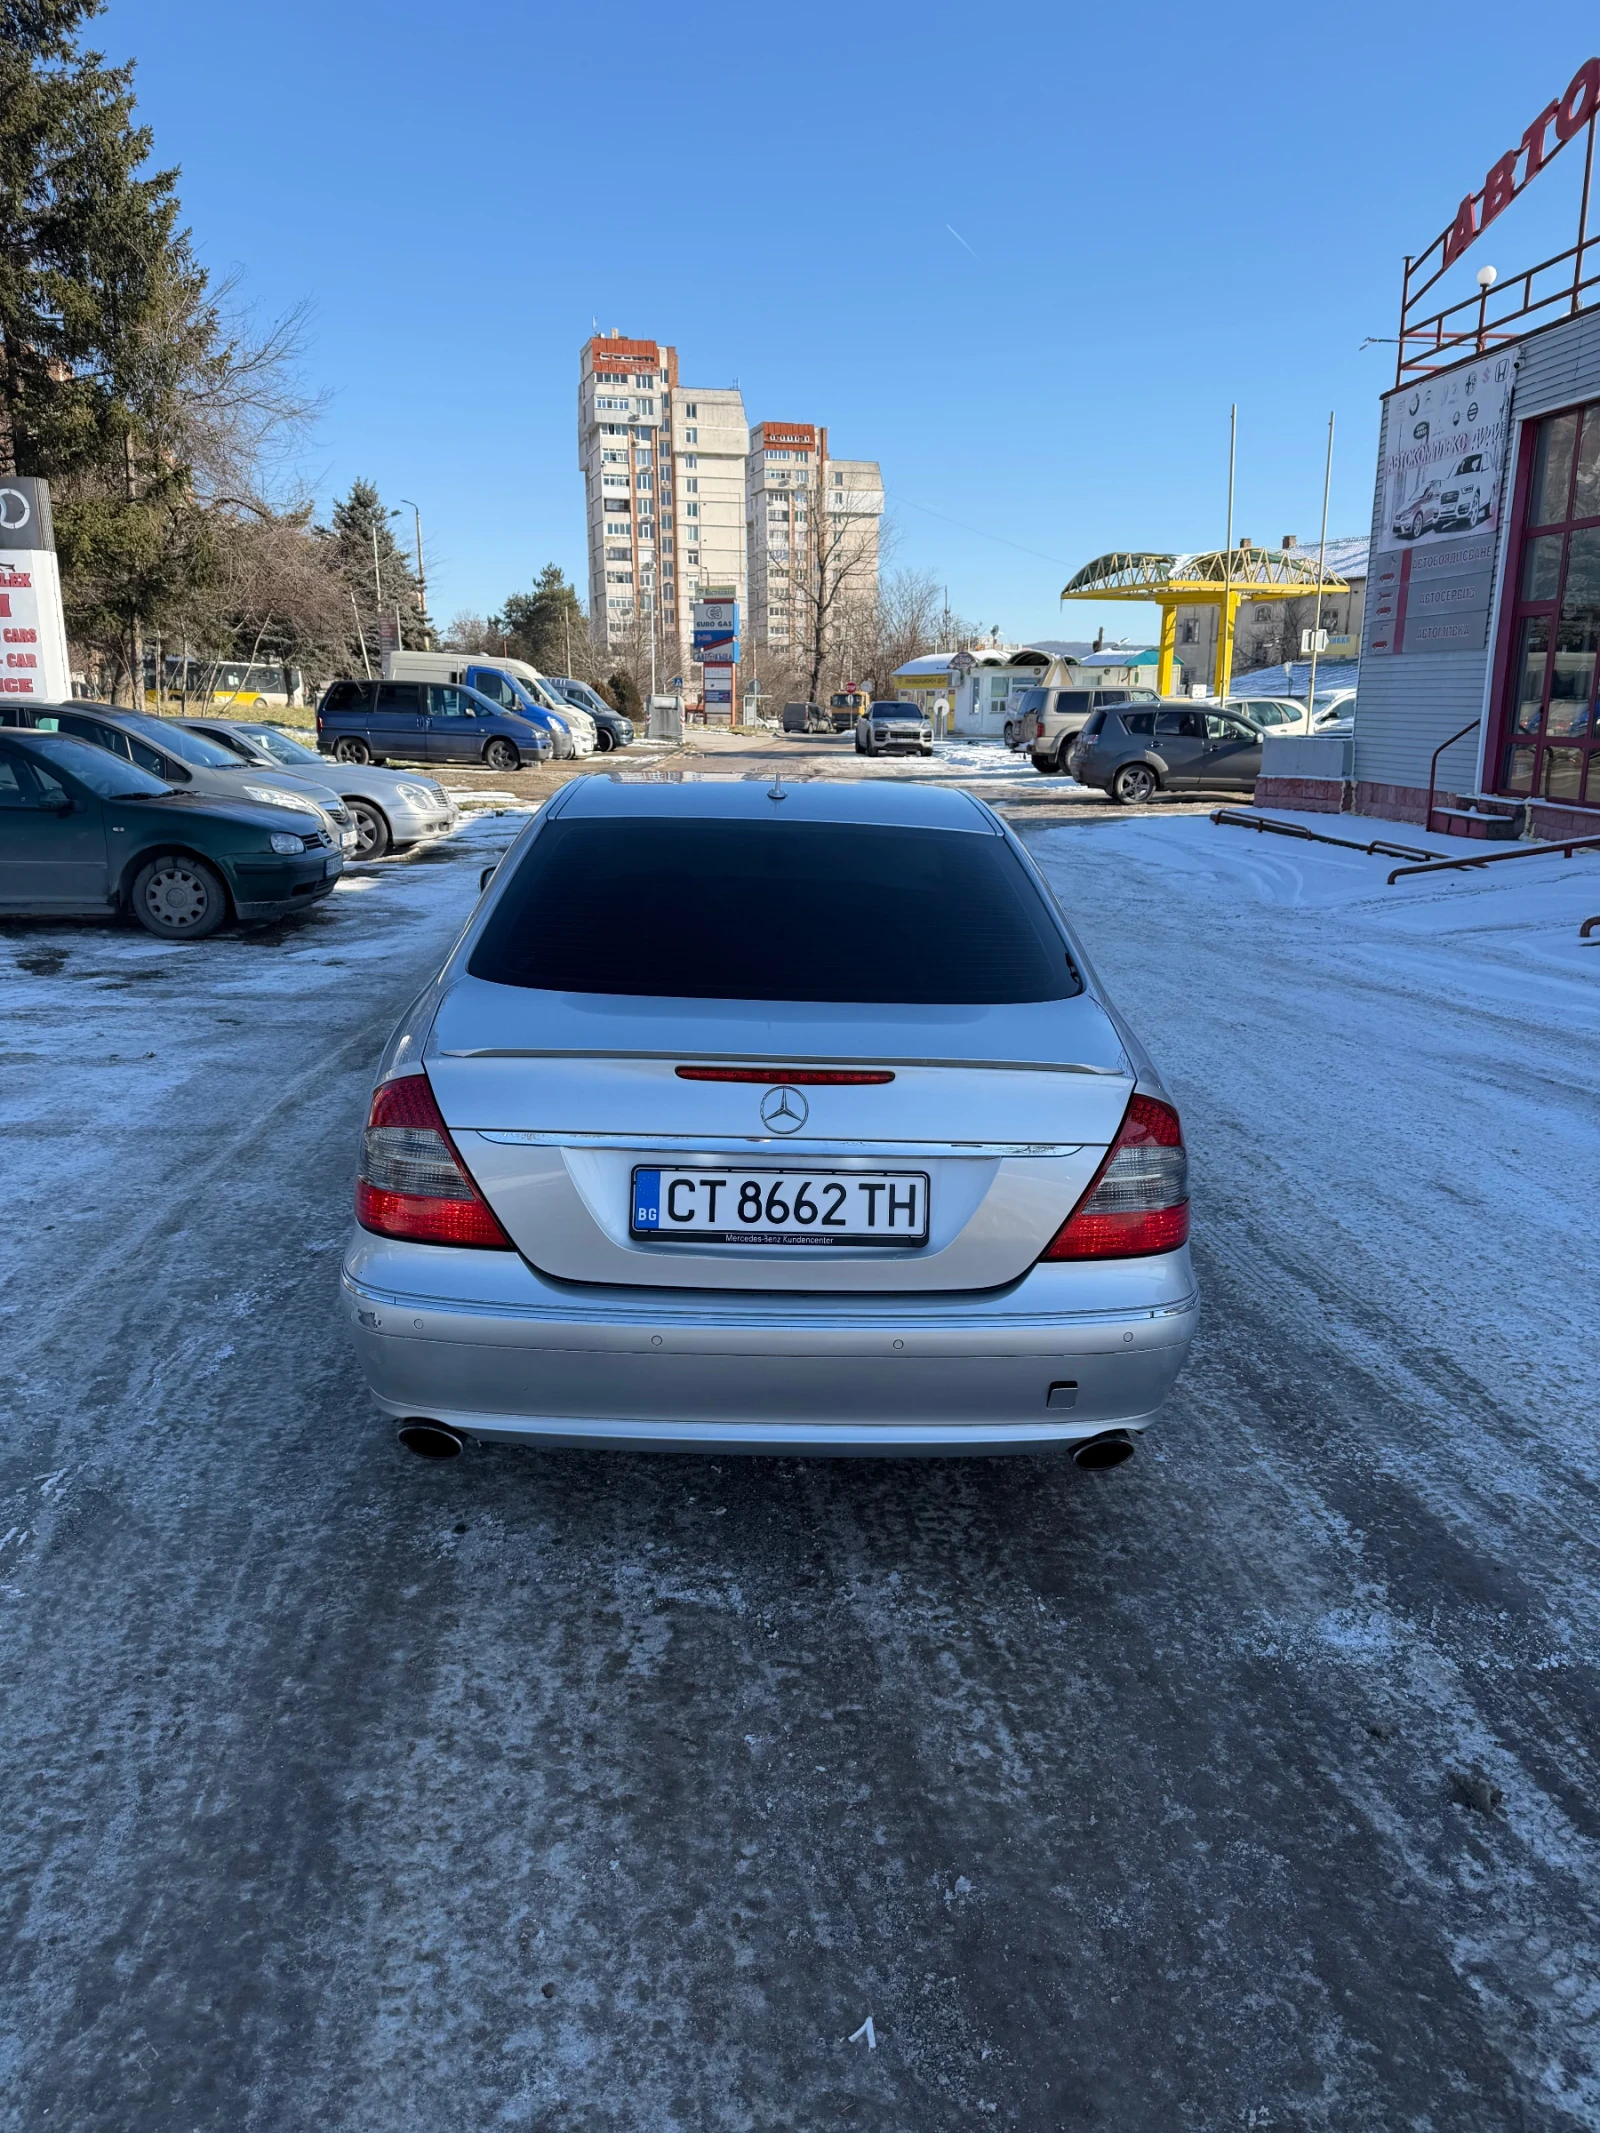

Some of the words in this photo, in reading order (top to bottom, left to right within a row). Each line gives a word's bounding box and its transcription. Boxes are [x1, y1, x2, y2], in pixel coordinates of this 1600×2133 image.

[1411, 545, 1493, 570] АВТОБОЯДИСВАНЕ
[1420, 586, 1475, 605] АВТОСЕРВИЗ
[3, 628, 37, 643] CARS
[1416, 624, 1469, 640] АВТОМИВКА
[6, 653, 37, 668] CAR
[667, 1178, 727, 1223] CT
[737, 1180, 847, 1226] 8662
[858, 1183, 916, 1227] TH
[638, 1207, 657, 1220] BG
[725, 1234, 781, 1243] Mercedes-Benz
[782, 1235, 834, 1244] Kundencenter
